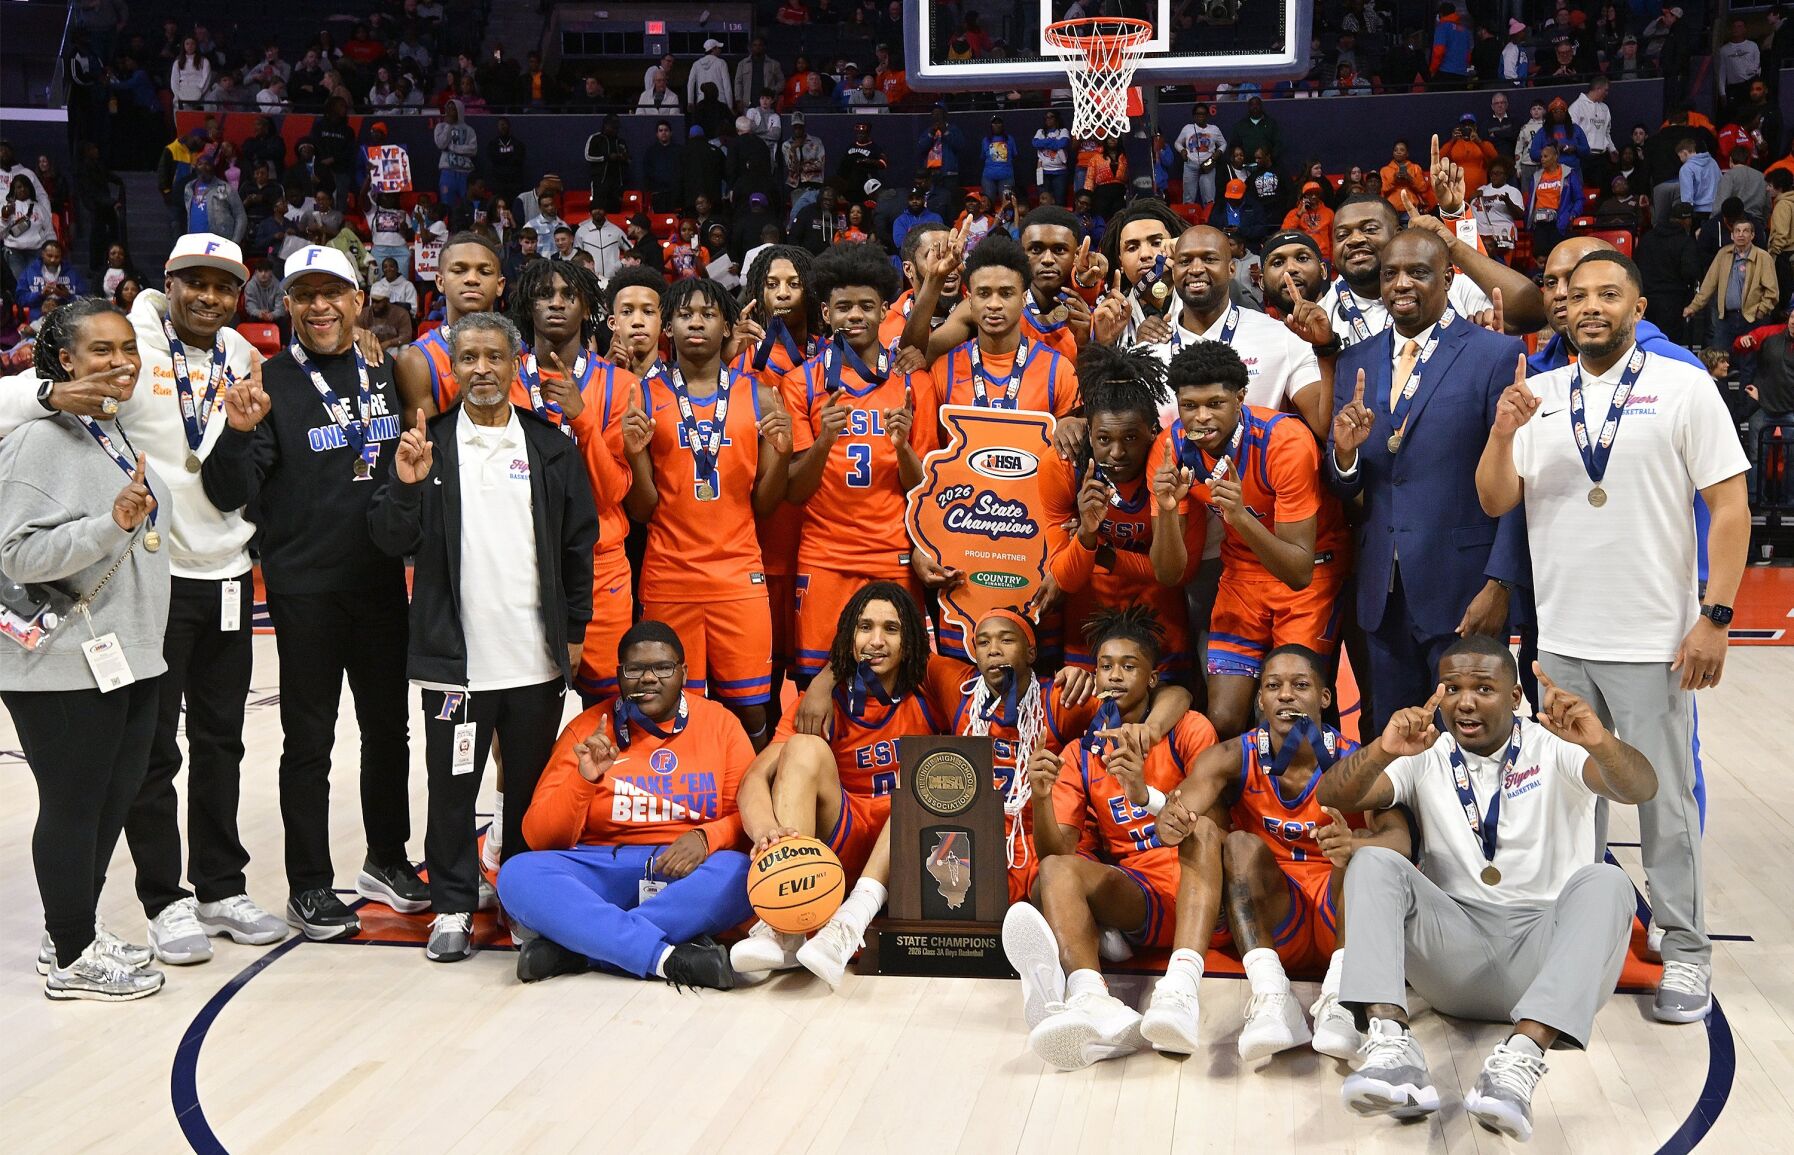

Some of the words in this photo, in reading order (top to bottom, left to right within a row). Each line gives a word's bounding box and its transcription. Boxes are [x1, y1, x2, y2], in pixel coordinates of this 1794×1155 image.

[205, 241, 220, 255] F
[306, 249, 322, 266] F
[846, 443, 872, 488] 3
[938, 486, 971, 507] 2026
[975, 495, 1024, 518] State
[948, 508, 1034, 536] Champion
[965, 550, 990, 559] PROUD
[991, 552, 1027, 562] PARTNER
[976, 572, 1022, 585] COUNTRY
[434, 691, 464, 720] F
[656, 753, 672, 770] F
[936, 754, 956, 763] HIGH
[956, 758, 975, 789] SCHOOL
[612, 775, 674, 797] MAKE
[1504, 764, 1540, 790] Flyers
[611, 793, 718, 822] BELIEVE
[923, 793, 970, 810] ASSOCIATION
[757, 846, 821, 872] Wilson
[779, 875, 815, 896] EVO
[896, 935, 928, 947] STATE
[930, 936, 996, 949] CHAMPIONS
